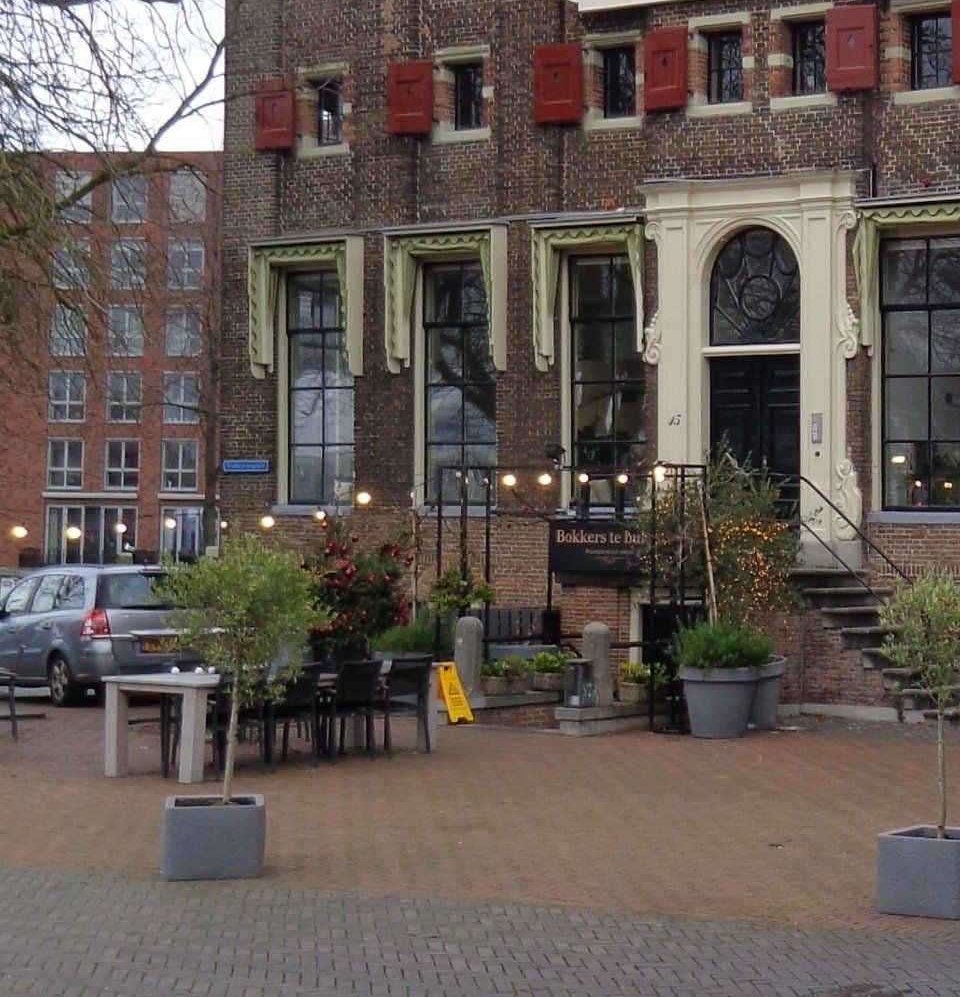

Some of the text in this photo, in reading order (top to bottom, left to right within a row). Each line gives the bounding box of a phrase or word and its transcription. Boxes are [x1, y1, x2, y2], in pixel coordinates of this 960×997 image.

[668, 414, 682, 426] 15
[556, 528, 607, 543] Bokkers
[609, 532, 621, 544] te
